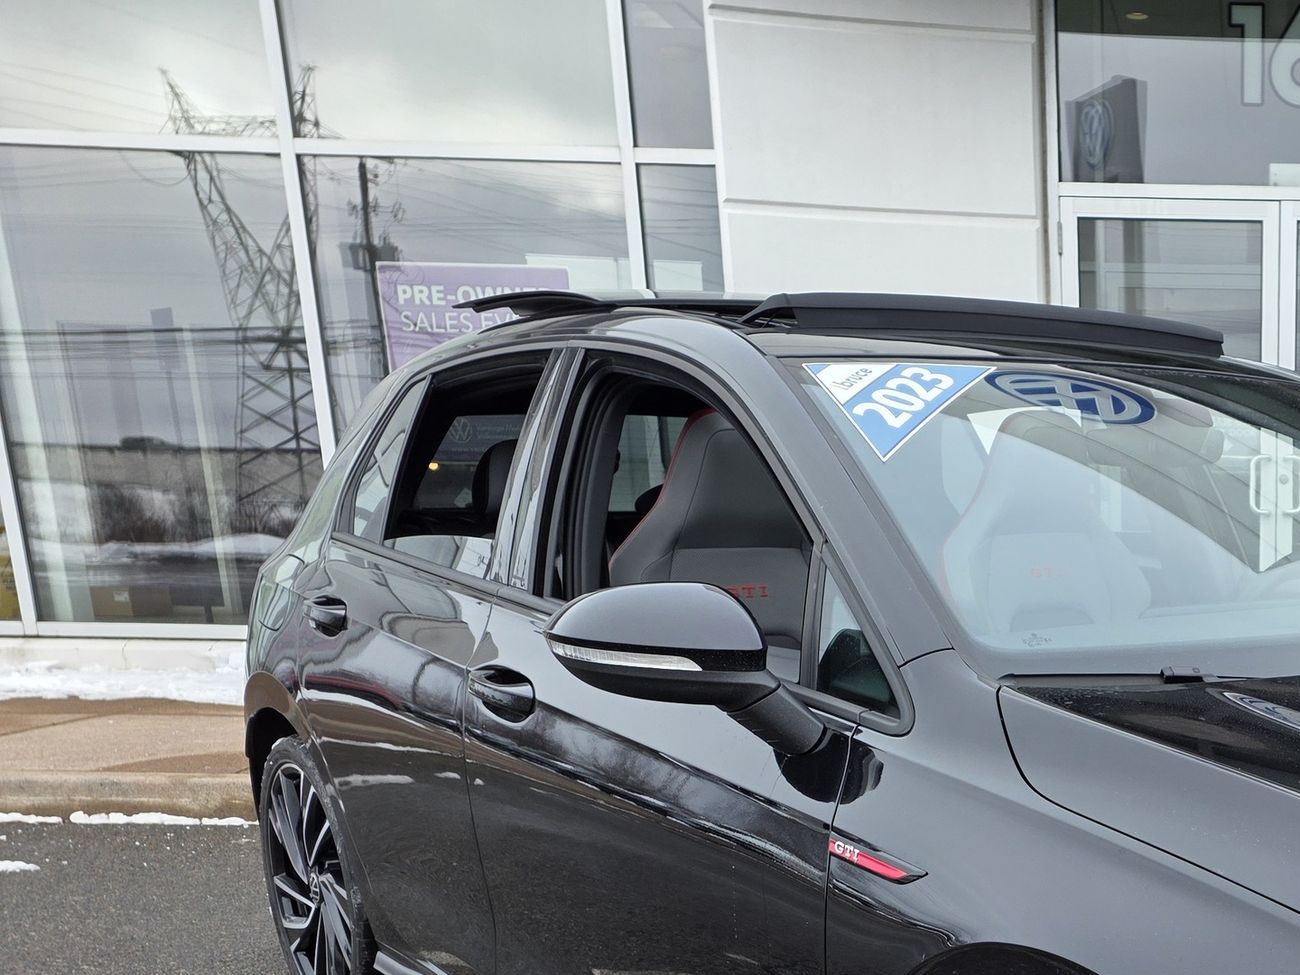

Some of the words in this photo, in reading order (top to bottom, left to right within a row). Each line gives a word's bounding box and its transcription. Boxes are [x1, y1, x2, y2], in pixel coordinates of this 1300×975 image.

[401, 311, 473, 333] SALES
[852, 366, 954, 428] 2023
[834, 840, 860, 862] GTI
